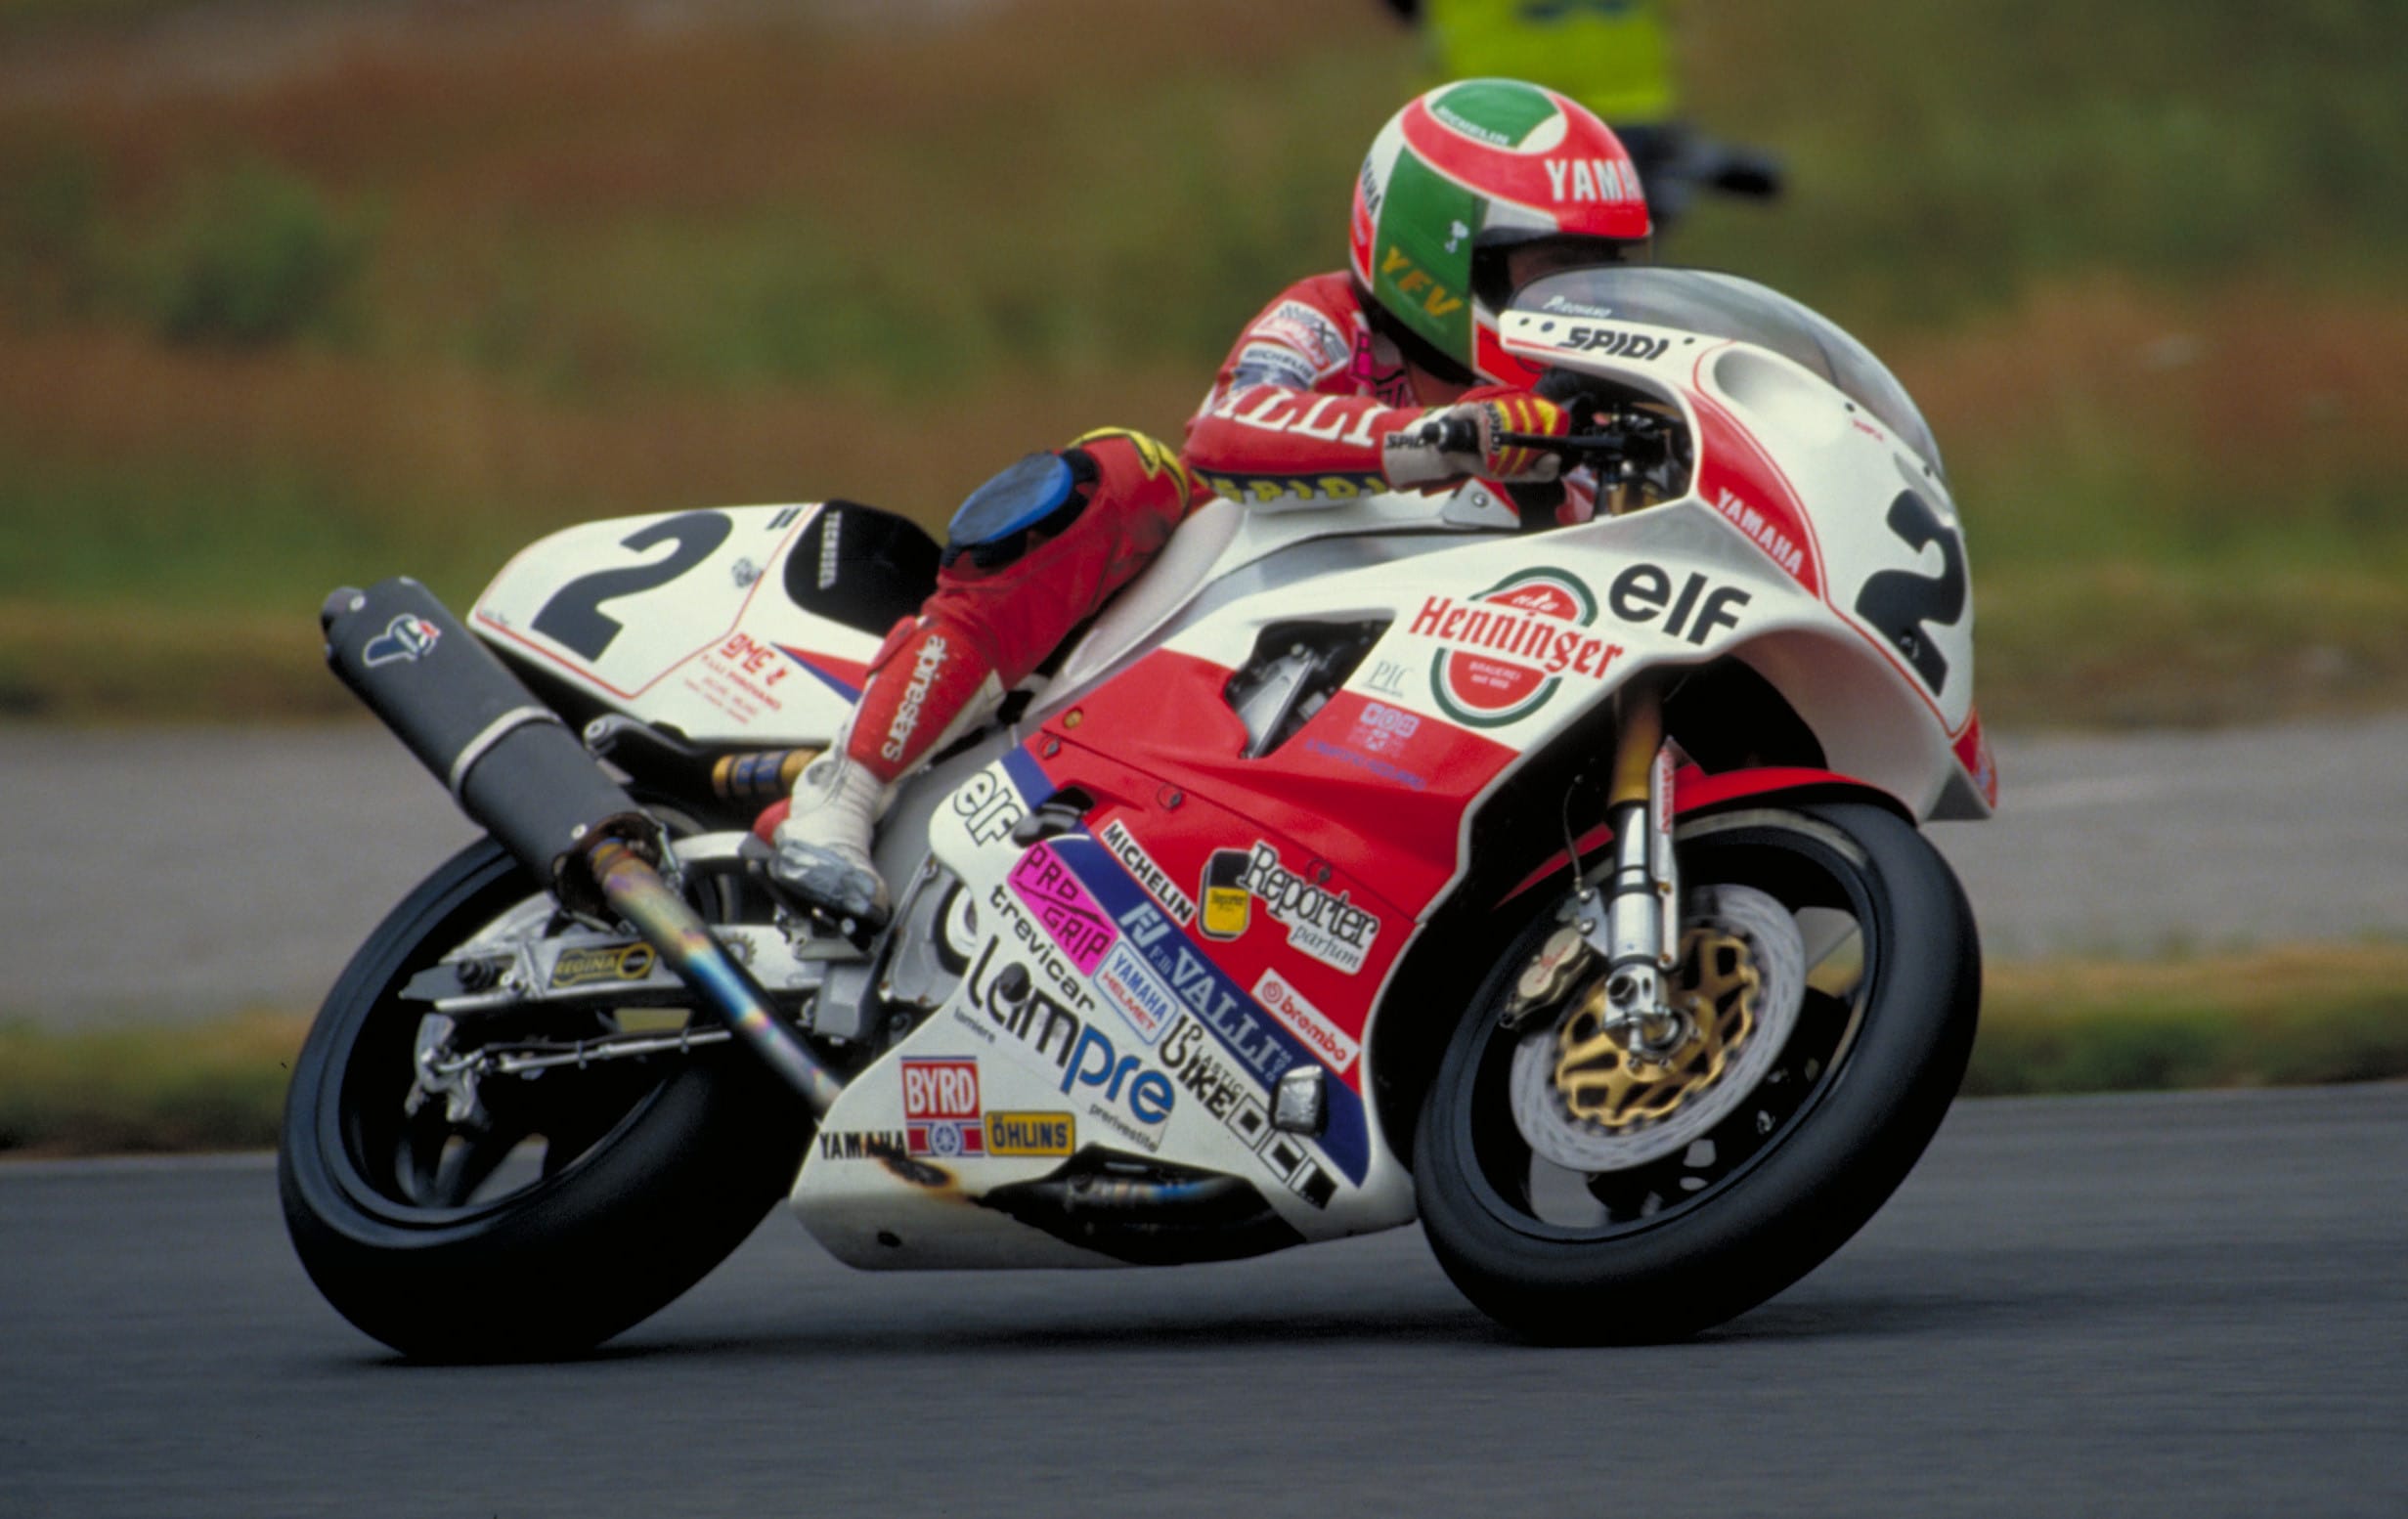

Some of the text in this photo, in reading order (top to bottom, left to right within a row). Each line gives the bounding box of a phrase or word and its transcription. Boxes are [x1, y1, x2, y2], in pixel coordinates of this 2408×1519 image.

[1554, 326, 1670, 361] SPIDI
[1716, 488, 1804, 575] YAMAHA
[530, 510, 733, 664] 2
[1608, 563, 1752, 646] elf
[1854, 489, 1967, 698] 2
[1408, 594, 1625, 680] Henninger
[882, 633, 948, 763] alpinestars
[953, 769, 1024, 847] elf
[1102, 822, 1196, 924] MICHELIN
[1238, 842, 1379, 950] Reporter
[989, 883, 1097, 1013] trevicar
[1042, 905, 1111, 963] GRIP
[1289, 923, 1361, 970] parfum
[1100, 972, 1158, 1033] HELMET
[1111, 952, 1169, 1023] YAMAHA
[1172, 944, 1282, 1076] VALLI
[1279, 995, 1348, 1063] brembo
[905, 1066, 977, 1116] BYRD
[819, 1130, 906, 1161] YAMAHA
[991, 1116, 1070, 1149] ÖHLINS
